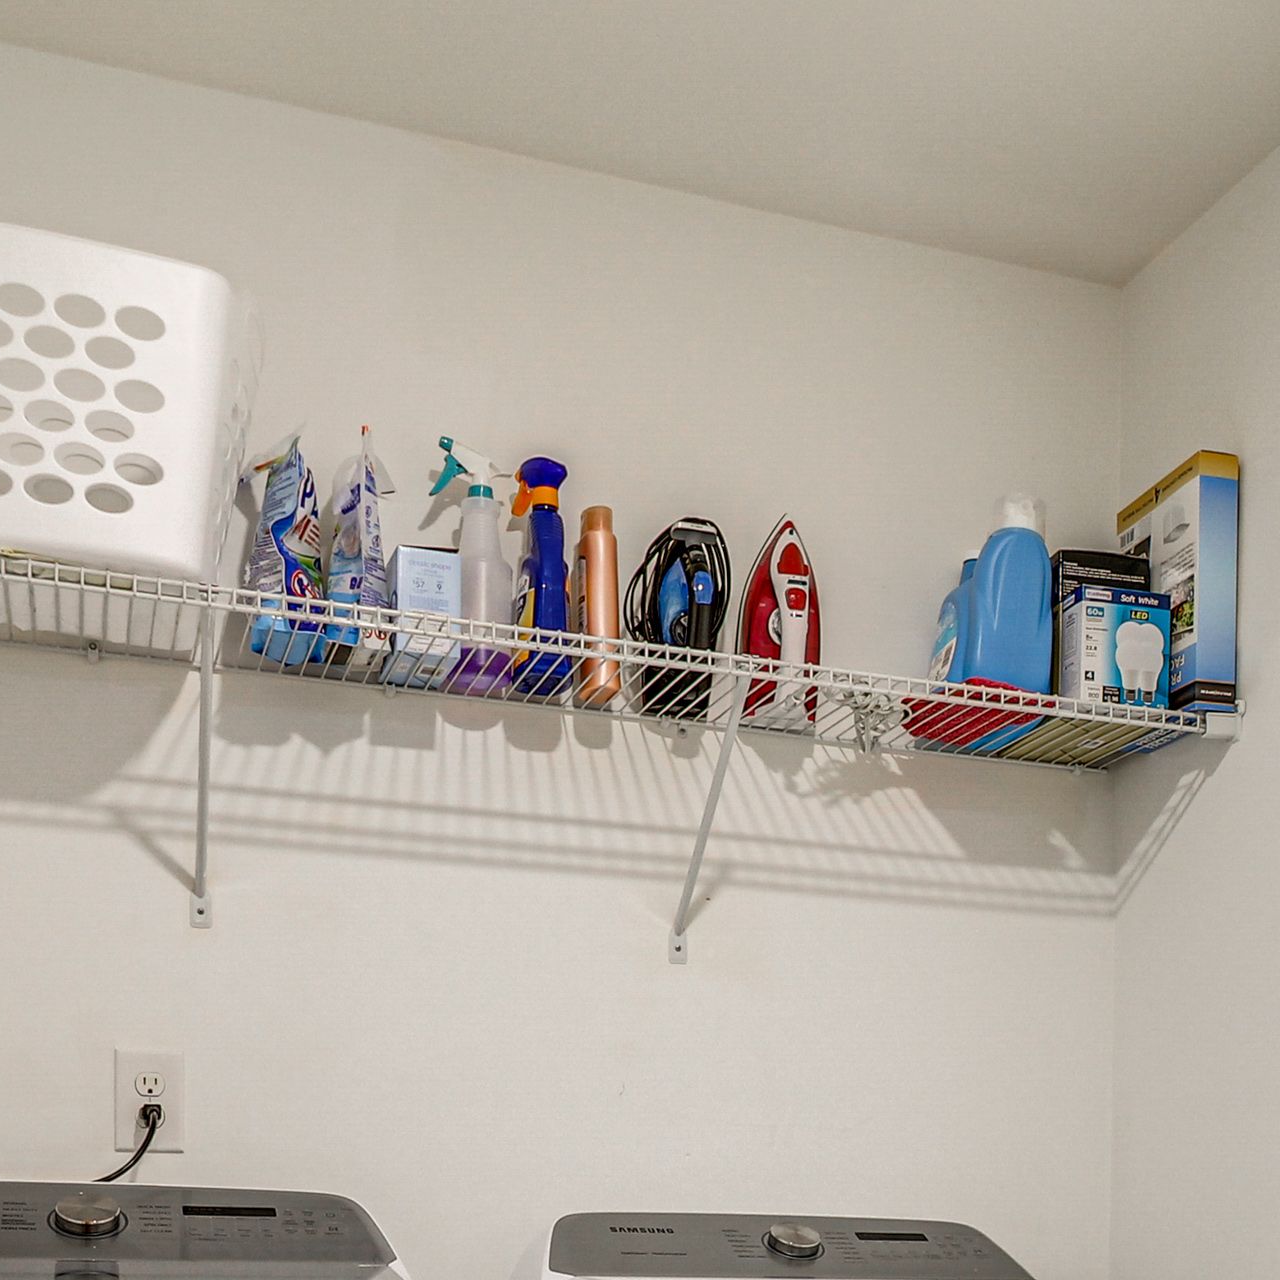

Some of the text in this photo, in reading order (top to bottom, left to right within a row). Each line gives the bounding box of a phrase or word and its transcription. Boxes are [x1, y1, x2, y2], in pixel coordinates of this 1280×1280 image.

[1120, 594, 1136, 603] Soft
[1138, 595, 1159, 606] White
[1131, 611, 1148, 620] LED
[609, 1226, 675, 1234] SAMSUNG
